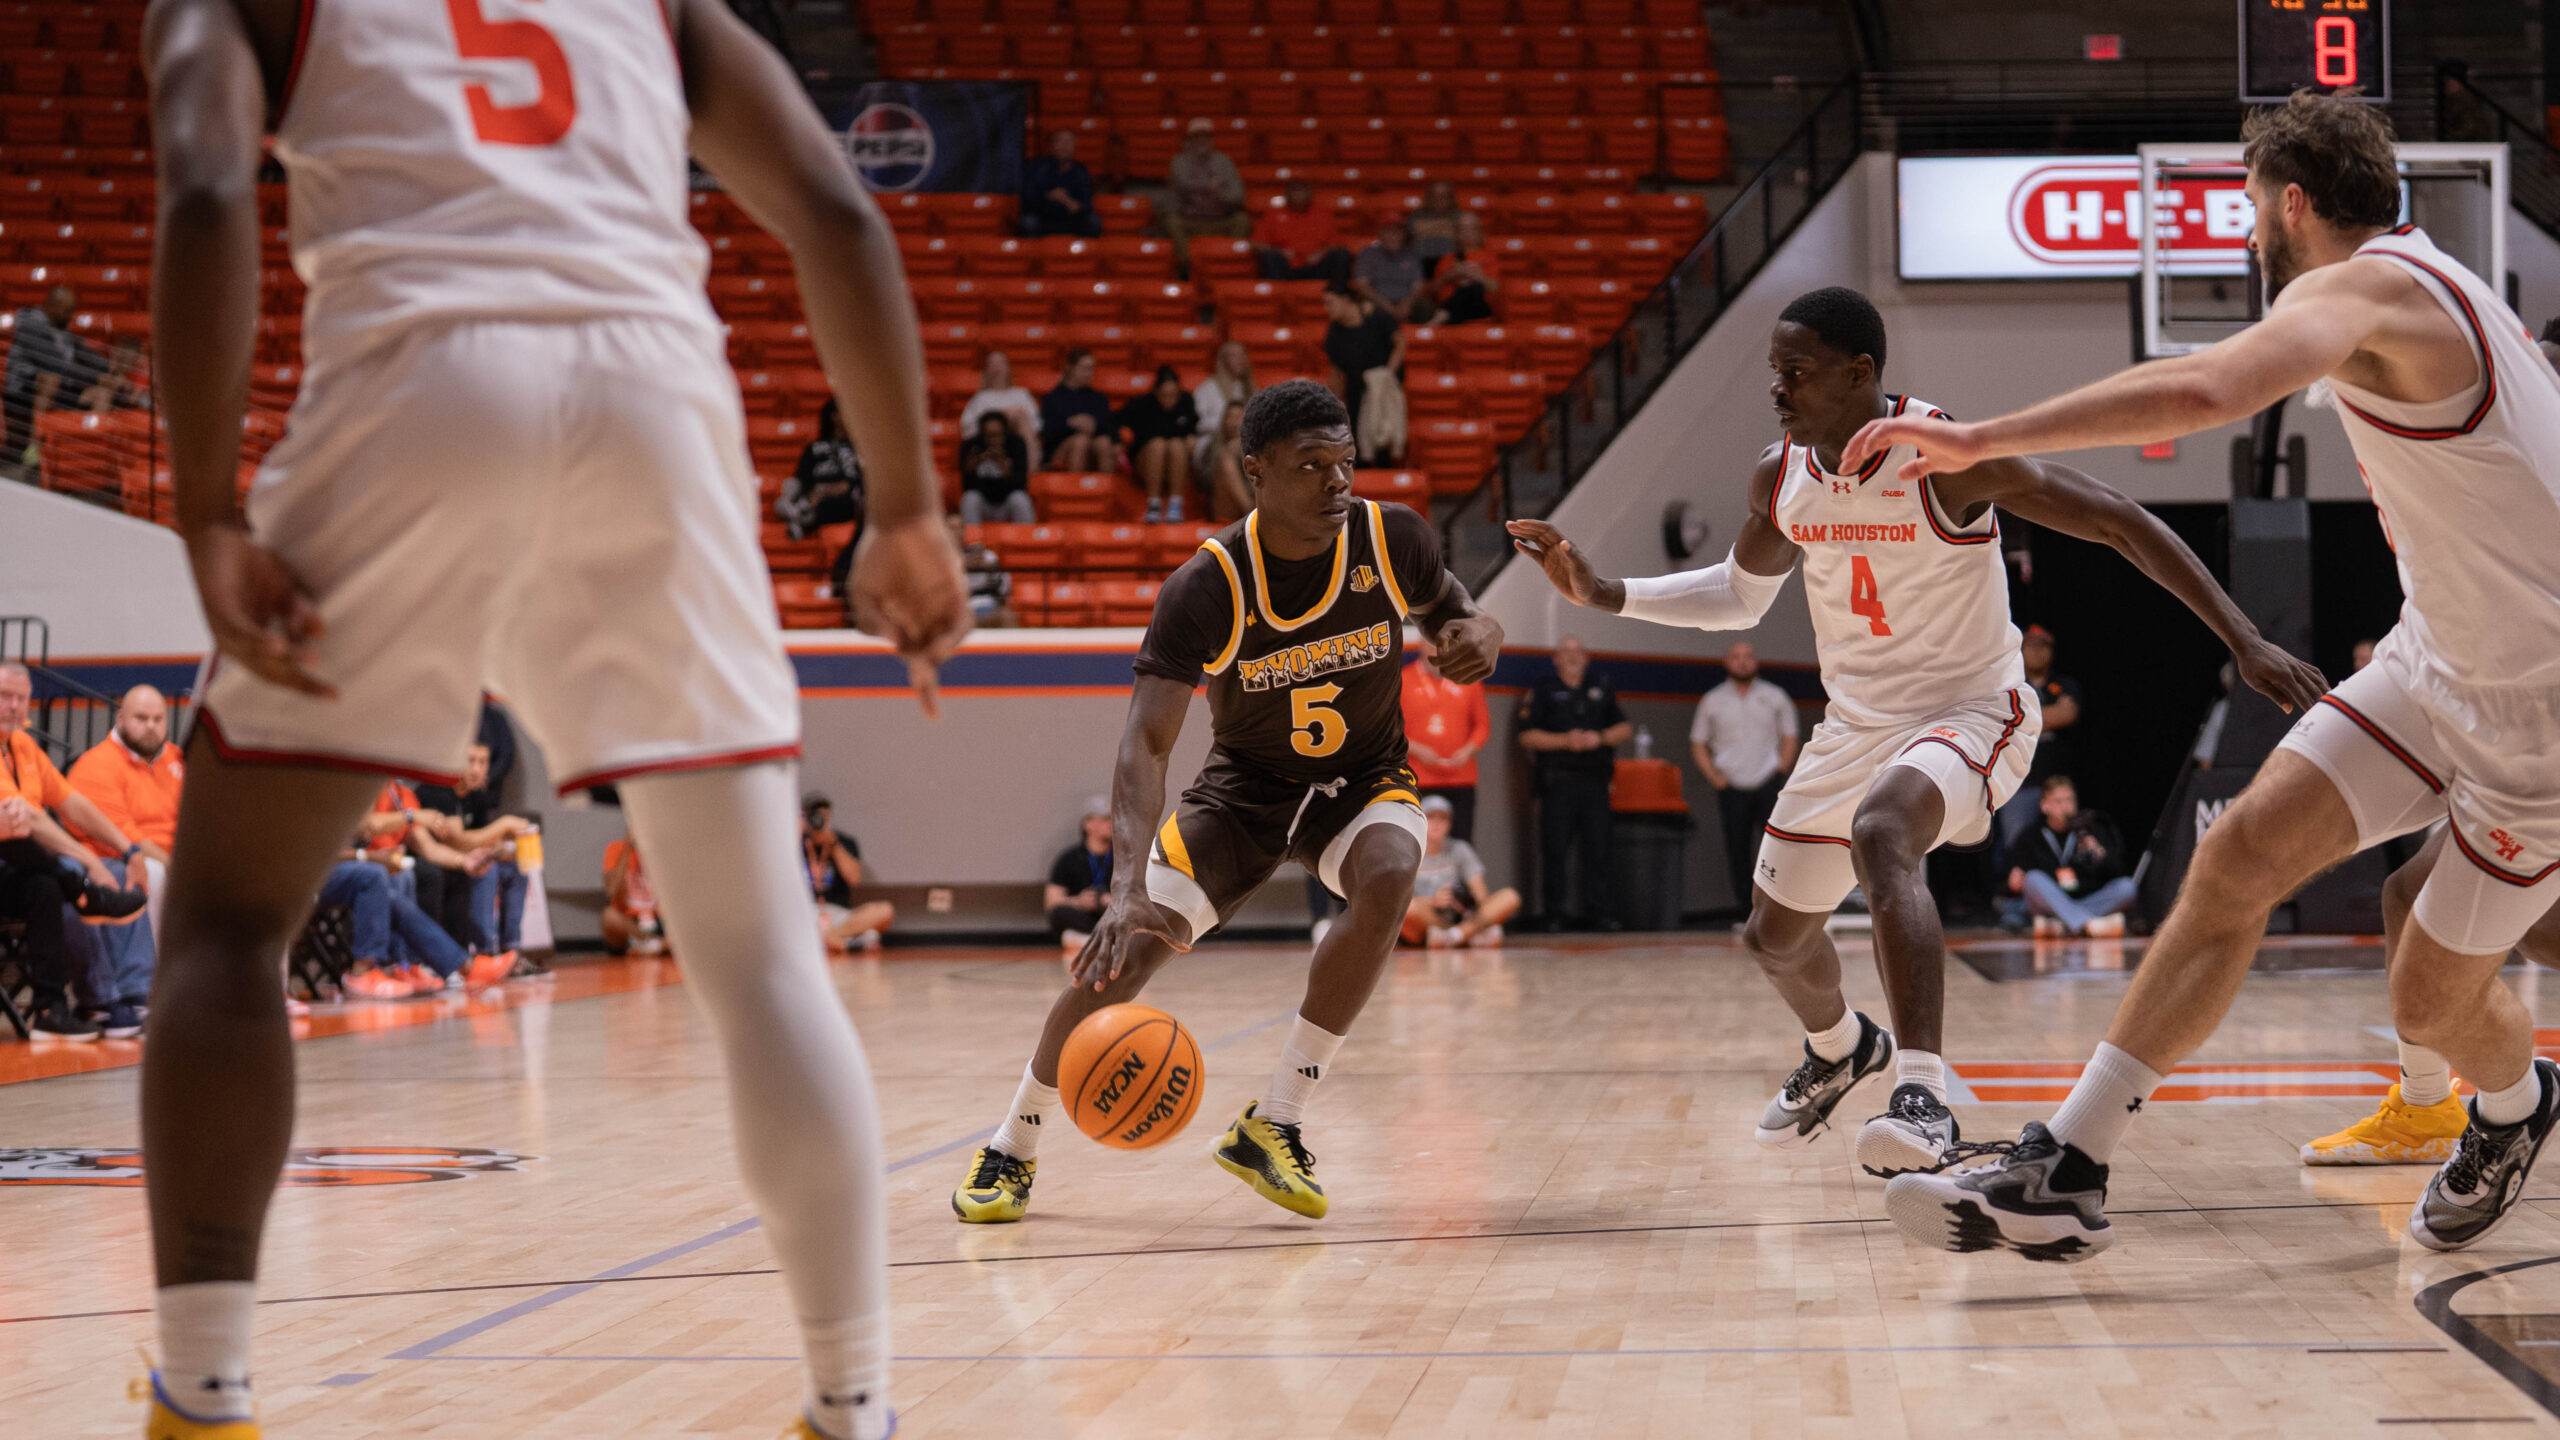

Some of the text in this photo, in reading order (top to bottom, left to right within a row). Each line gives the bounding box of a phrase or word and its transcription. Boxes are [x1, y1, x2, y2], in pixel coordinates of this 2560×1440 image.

[446, 0, 576, 145] 5
[2315, 16, 2357, 86] 8
[1791, 523, 1917, 542] SAM HOUSTON
[1850, 556, 1893, 636] 4
[1238, 620, 1391, 692] WYOMING
[1290, 681, 1350, 758] 5
[1093, 1052, 1146, 1115] NCAA
[1120, 1065, 1191, 1142] Wilson
